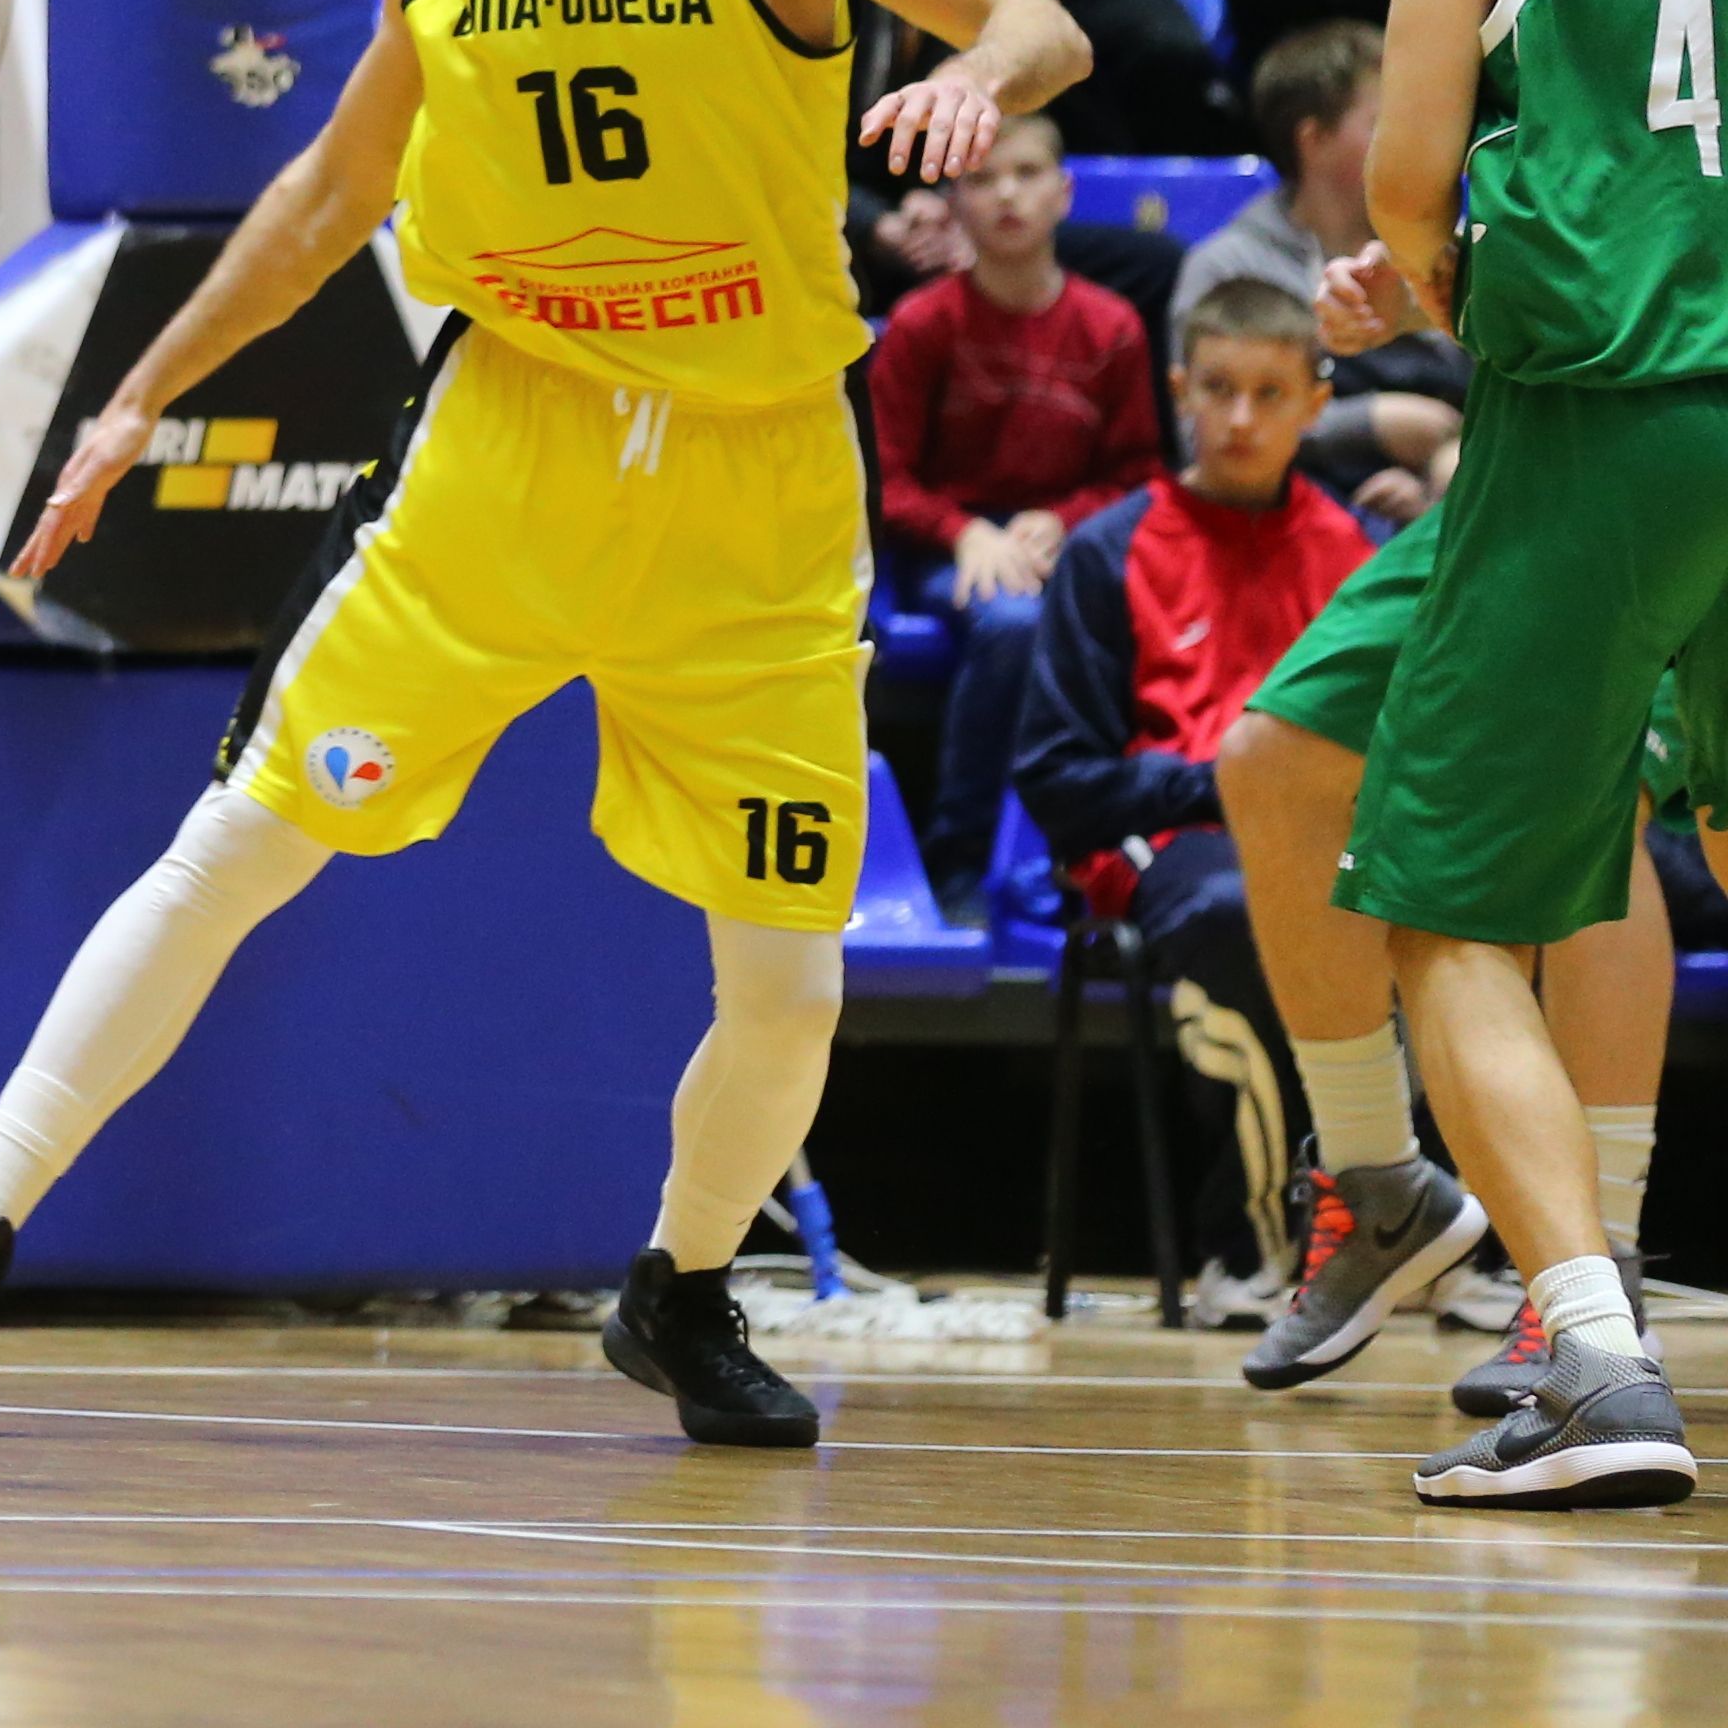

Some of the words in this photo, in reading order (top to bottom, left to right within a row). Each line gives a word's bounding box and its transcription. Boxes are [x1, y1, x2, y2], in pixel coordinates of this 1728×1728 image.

[517, 67, 650, 183] 16
[225, 461, 374, 512] MAT
[738, 798, 832, 885] 16
